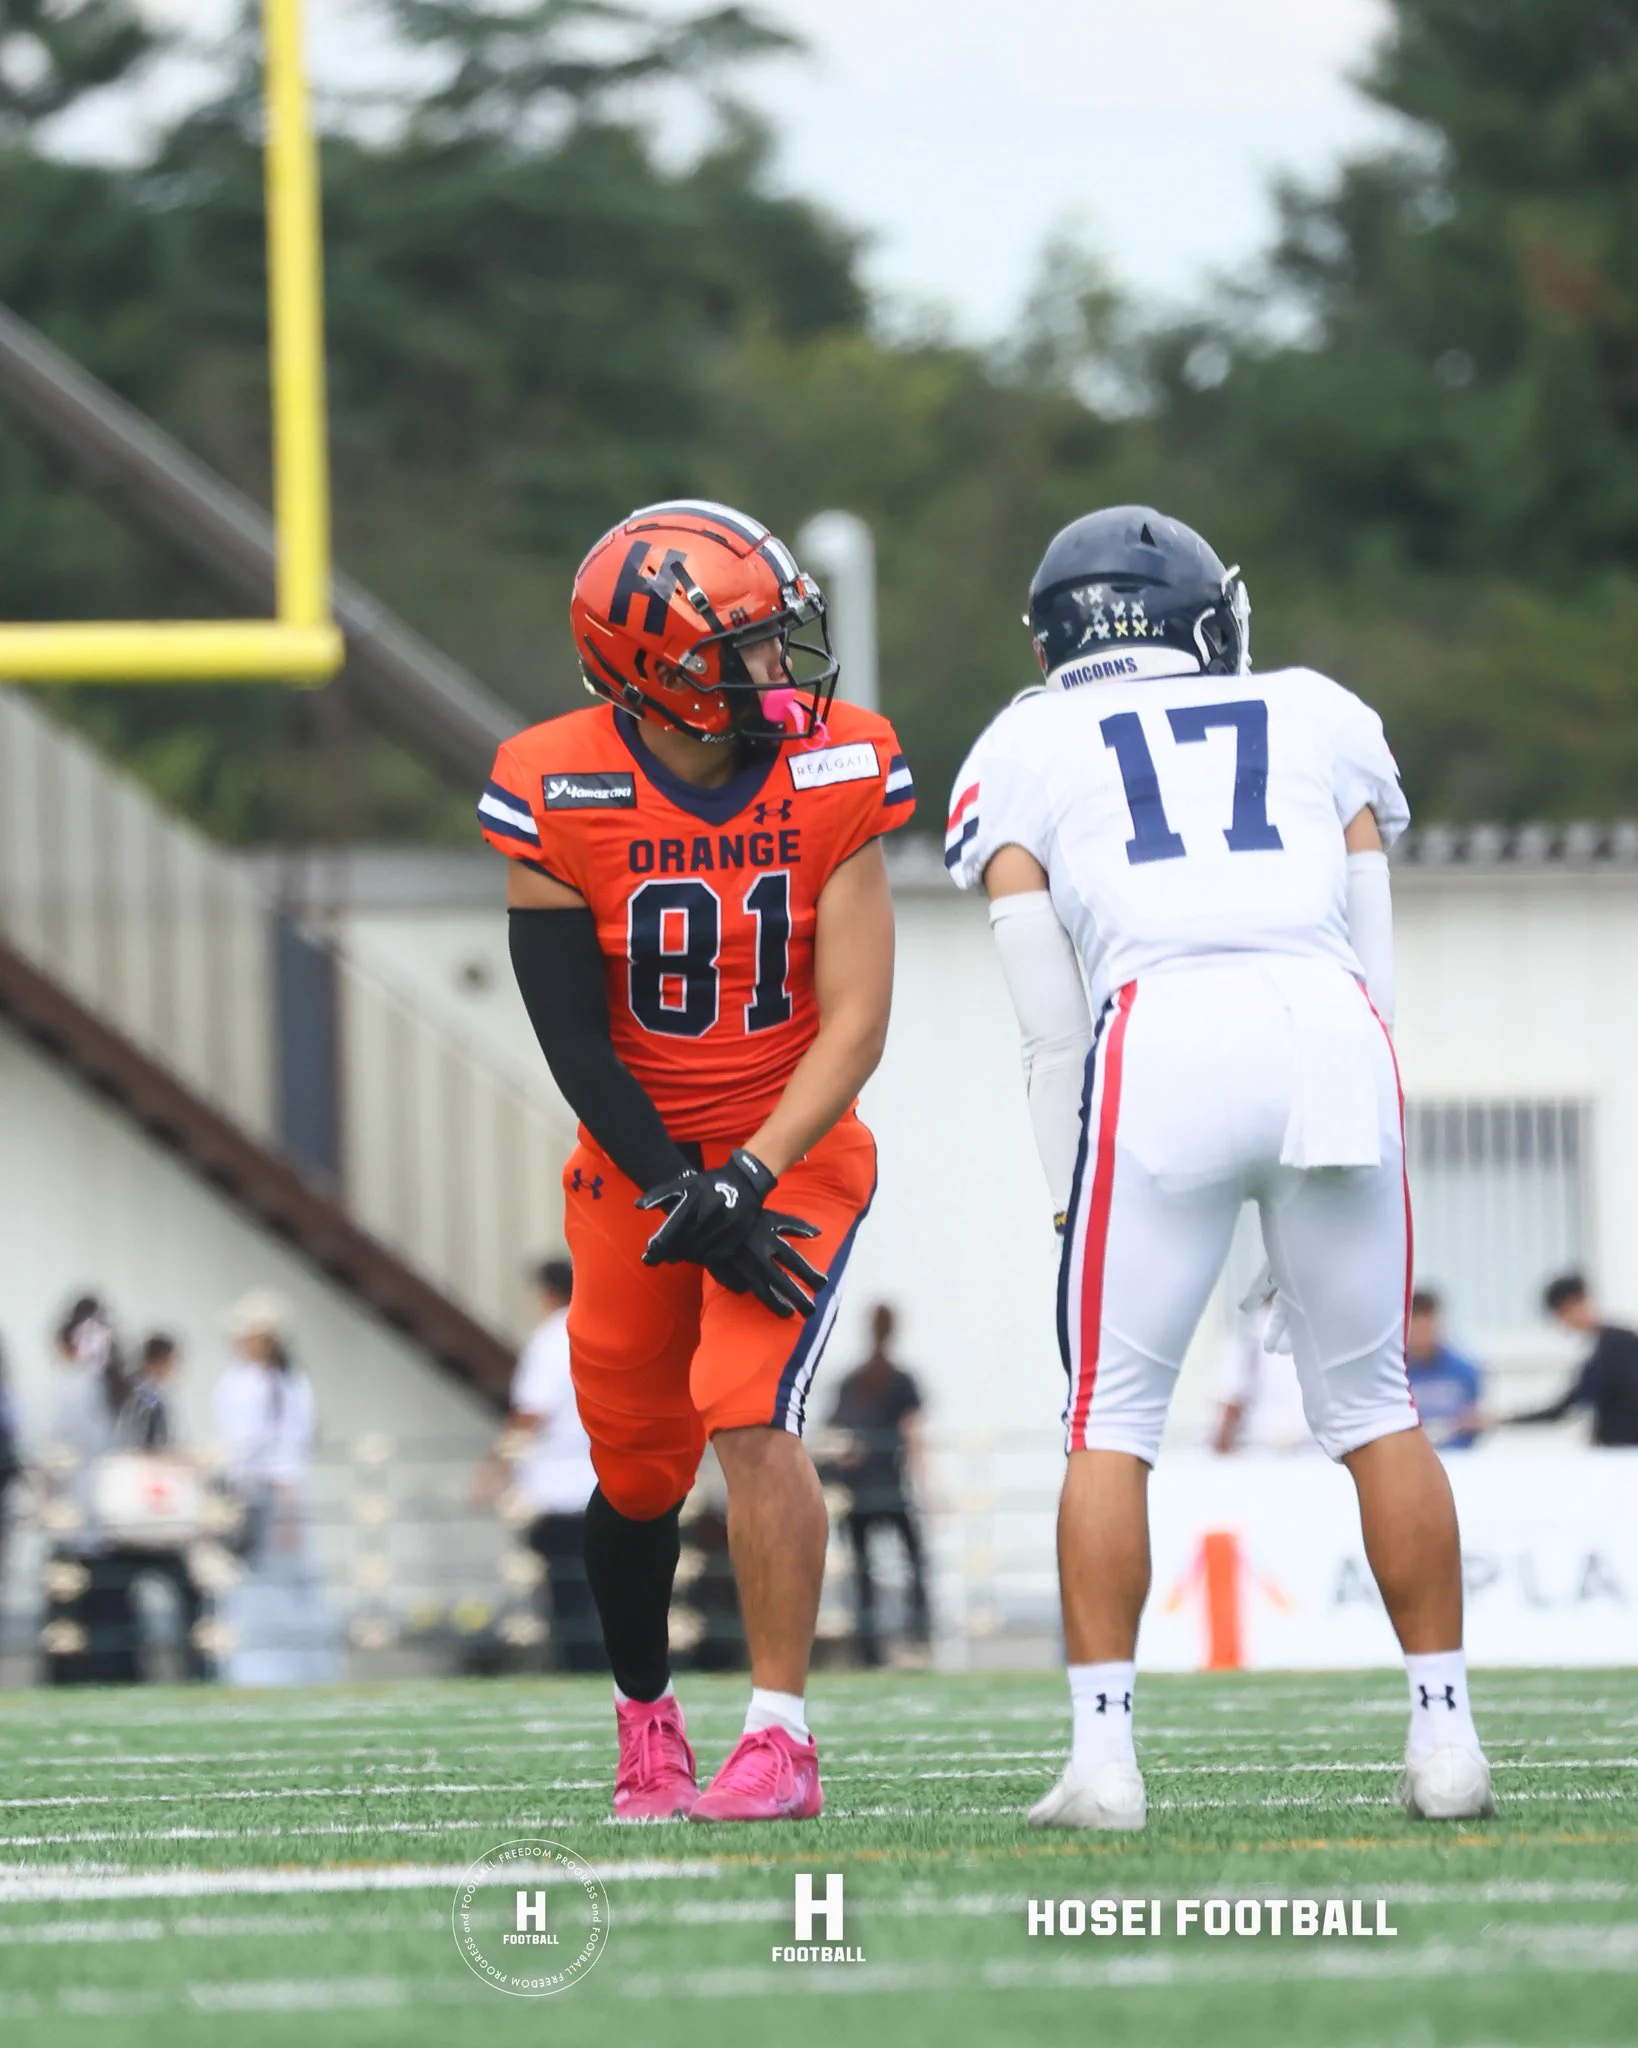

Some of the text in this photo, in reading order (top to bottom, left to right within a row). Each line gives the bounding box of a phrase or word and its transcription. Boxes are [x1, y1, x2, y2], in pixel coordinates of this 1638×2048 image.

[1060, 656, 1138, 690] UNICORNS
[1099, 700, 1285, 865] 17
[629, 829, 800, 873] ORANGE
[627, 869, 792, 1039] 81
